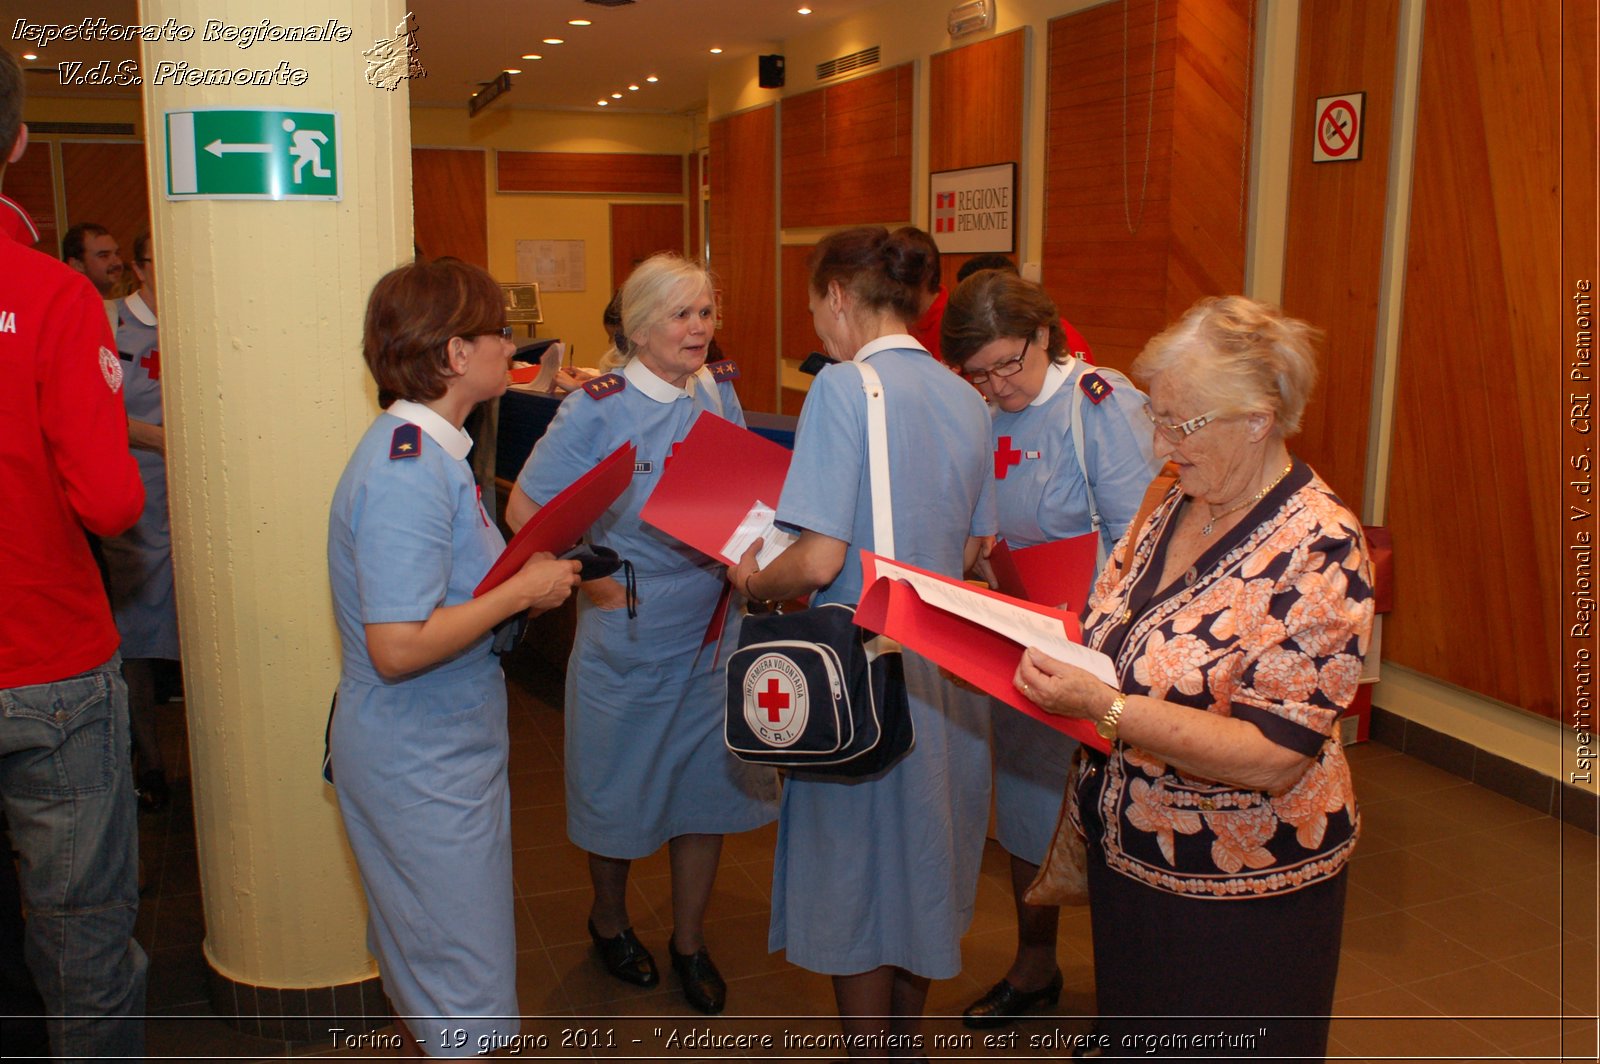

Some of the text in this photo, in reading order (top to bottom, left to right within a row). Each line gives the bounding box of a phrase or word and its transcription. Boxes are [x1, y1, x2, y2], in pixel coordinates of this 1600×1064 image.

[957, 187, 1009, 211] REGIONE
[957, 211, 1008, 232] PIEMONTE
[746, 659, 804, 699] INFERMIERA VOLONTARIA
